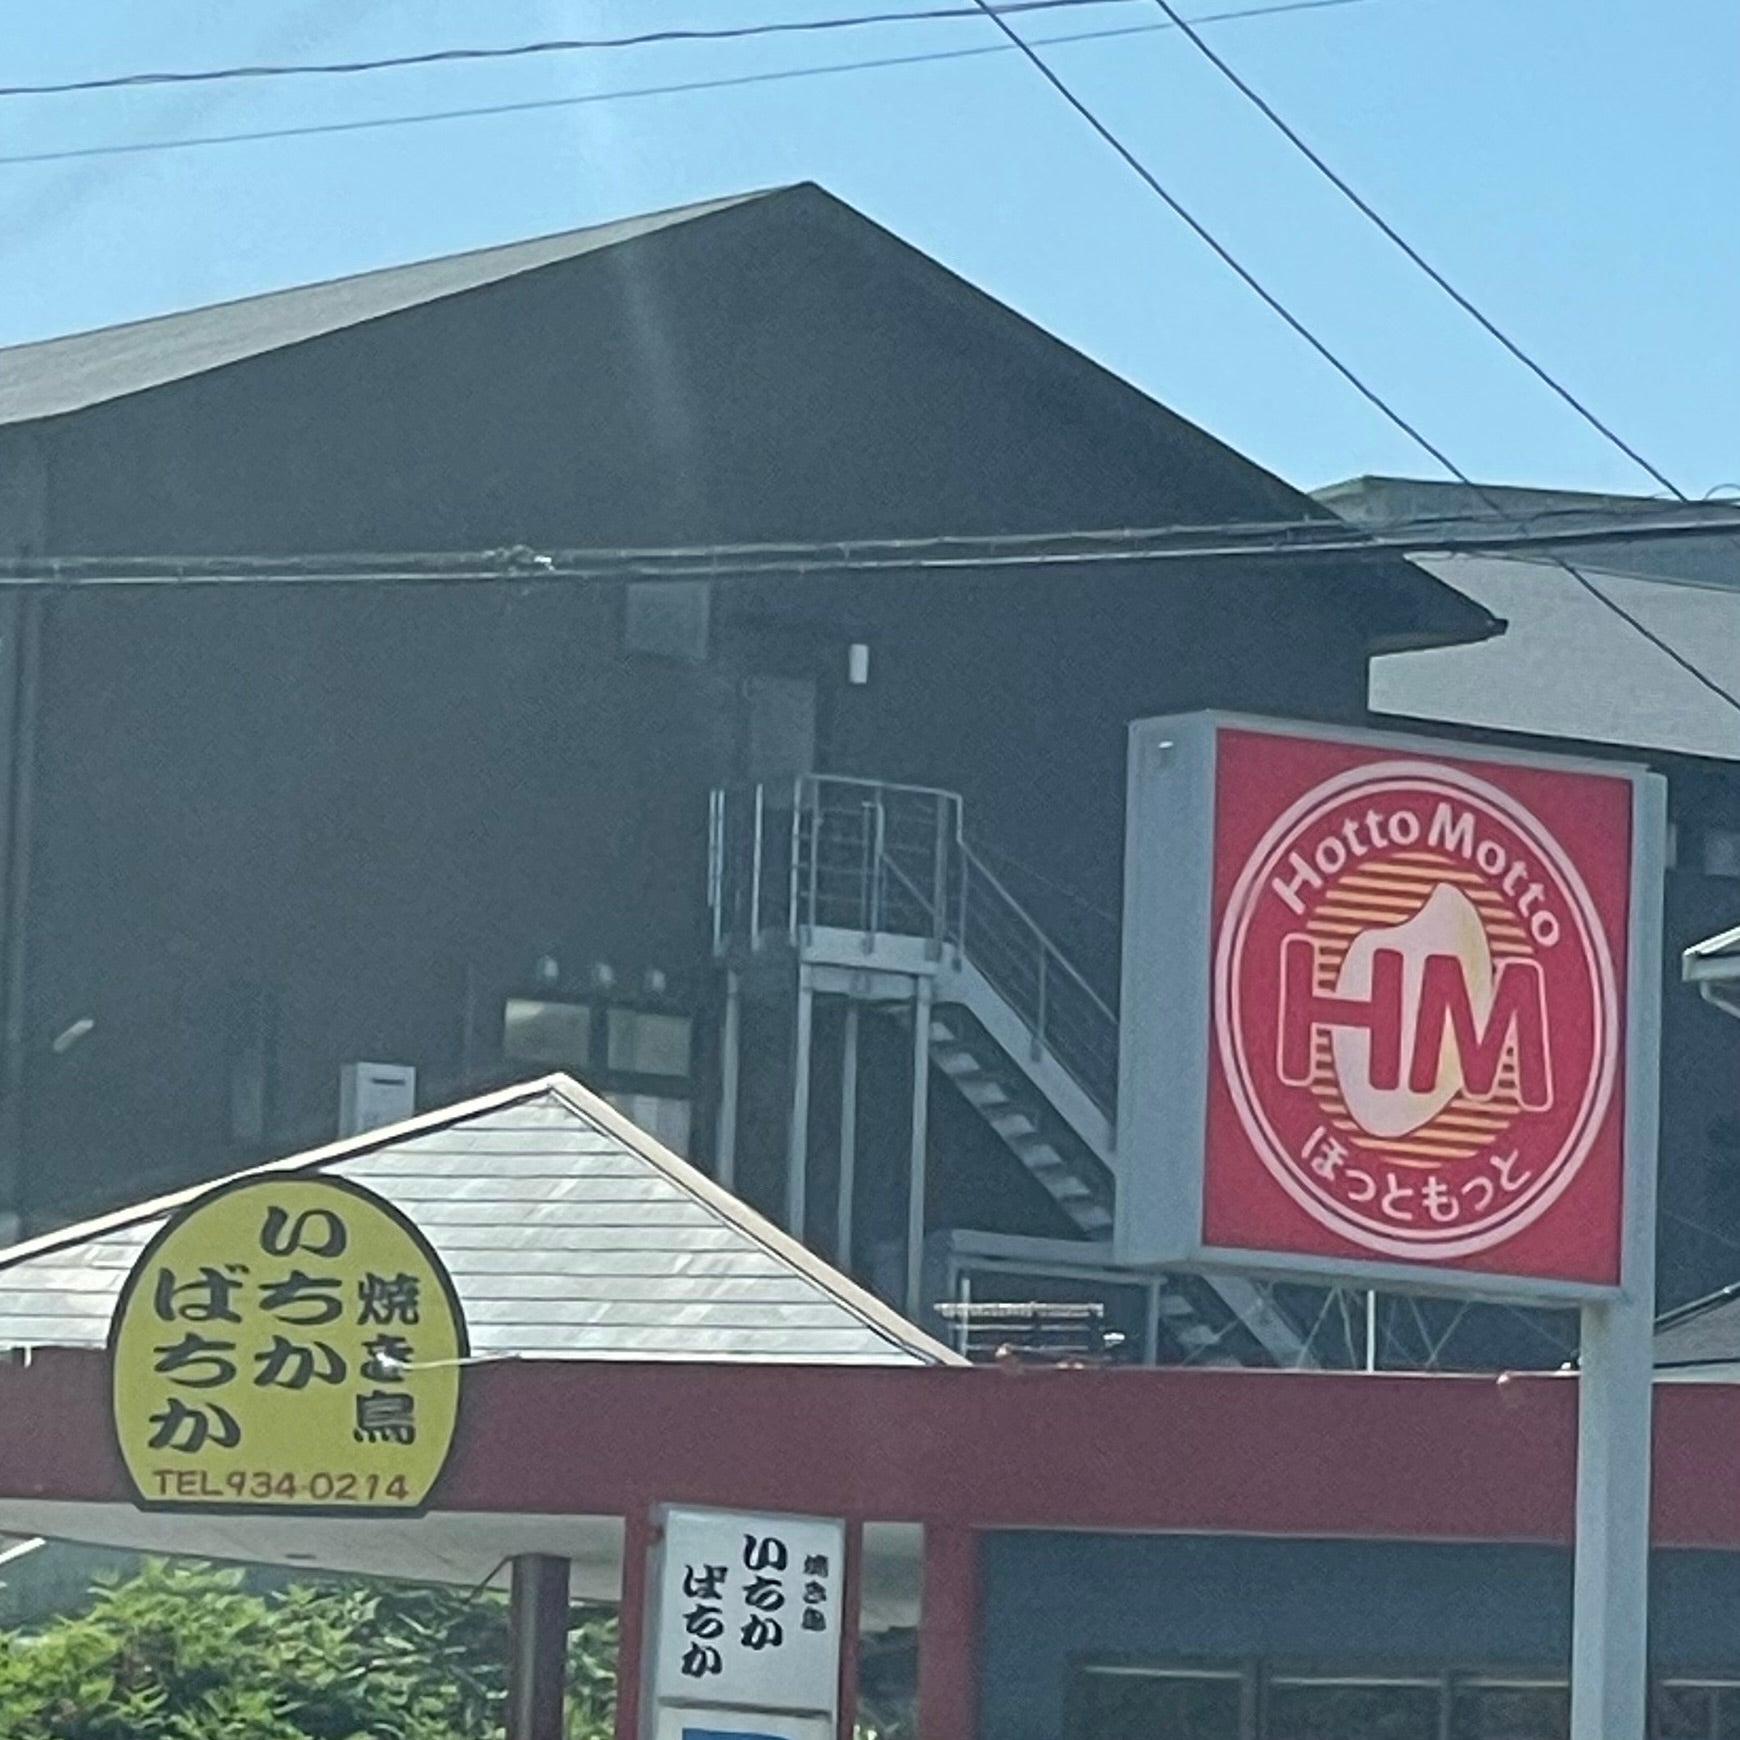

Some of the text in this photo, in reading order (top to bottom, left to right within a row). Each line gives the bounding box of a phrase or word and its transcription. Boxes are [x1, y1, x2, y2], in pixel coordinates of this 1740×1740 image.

[1275, 931, 1555, 1113] HM
[1301, 1125, 1532, 1223] ほっともっと
[147, 1263, 250, 1454] ばちか
[253, 1205, 348, 1390] いちか
[352, 1271, 421, 1446] 焼き鳥
[153, 1468, 223, 1497] TEL
[741, 1533, 789, 1651] いちか
